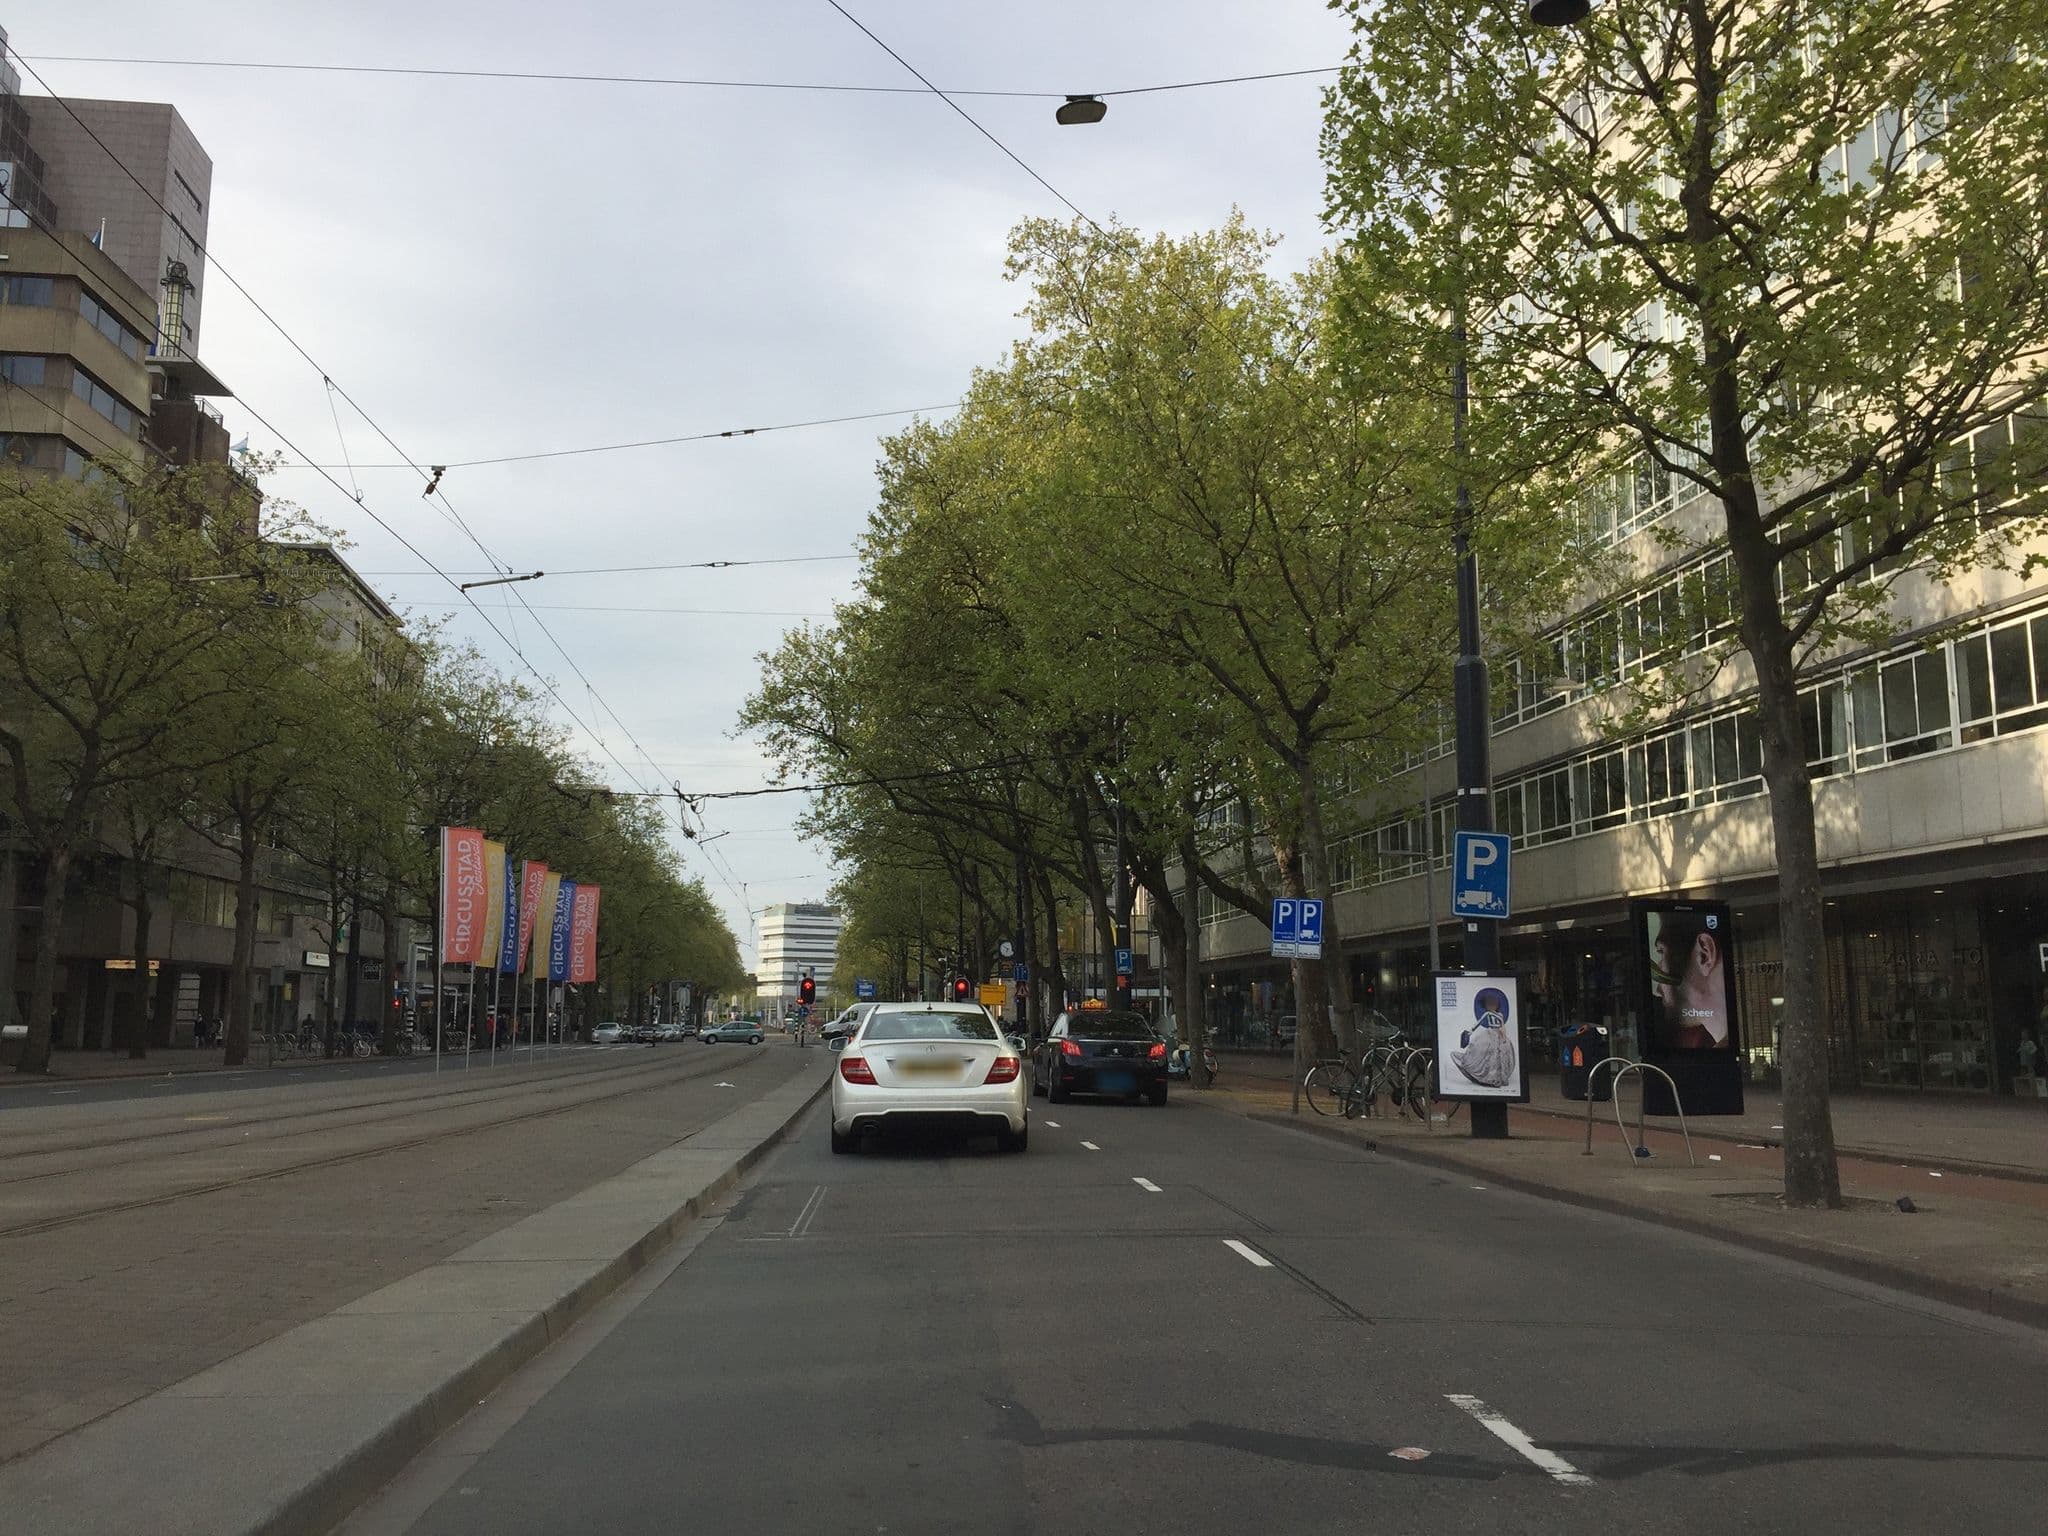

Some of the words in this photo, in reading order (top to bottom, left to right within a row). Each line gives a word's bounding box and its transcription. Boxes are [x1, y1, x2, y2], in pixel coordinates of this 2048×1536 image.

[1466, 839, 1498, 880] P
[451, 839, 473, 956] CIRCUSSTAD
[519, 871, 538, 962] IRCUSSTAD
[1279, 902, 1293, 924] P
[1303, 903, 1317, 925] P
[1119, 952, 1128, 964] P
[1681, 1008, 1714, 1018] Scheer
